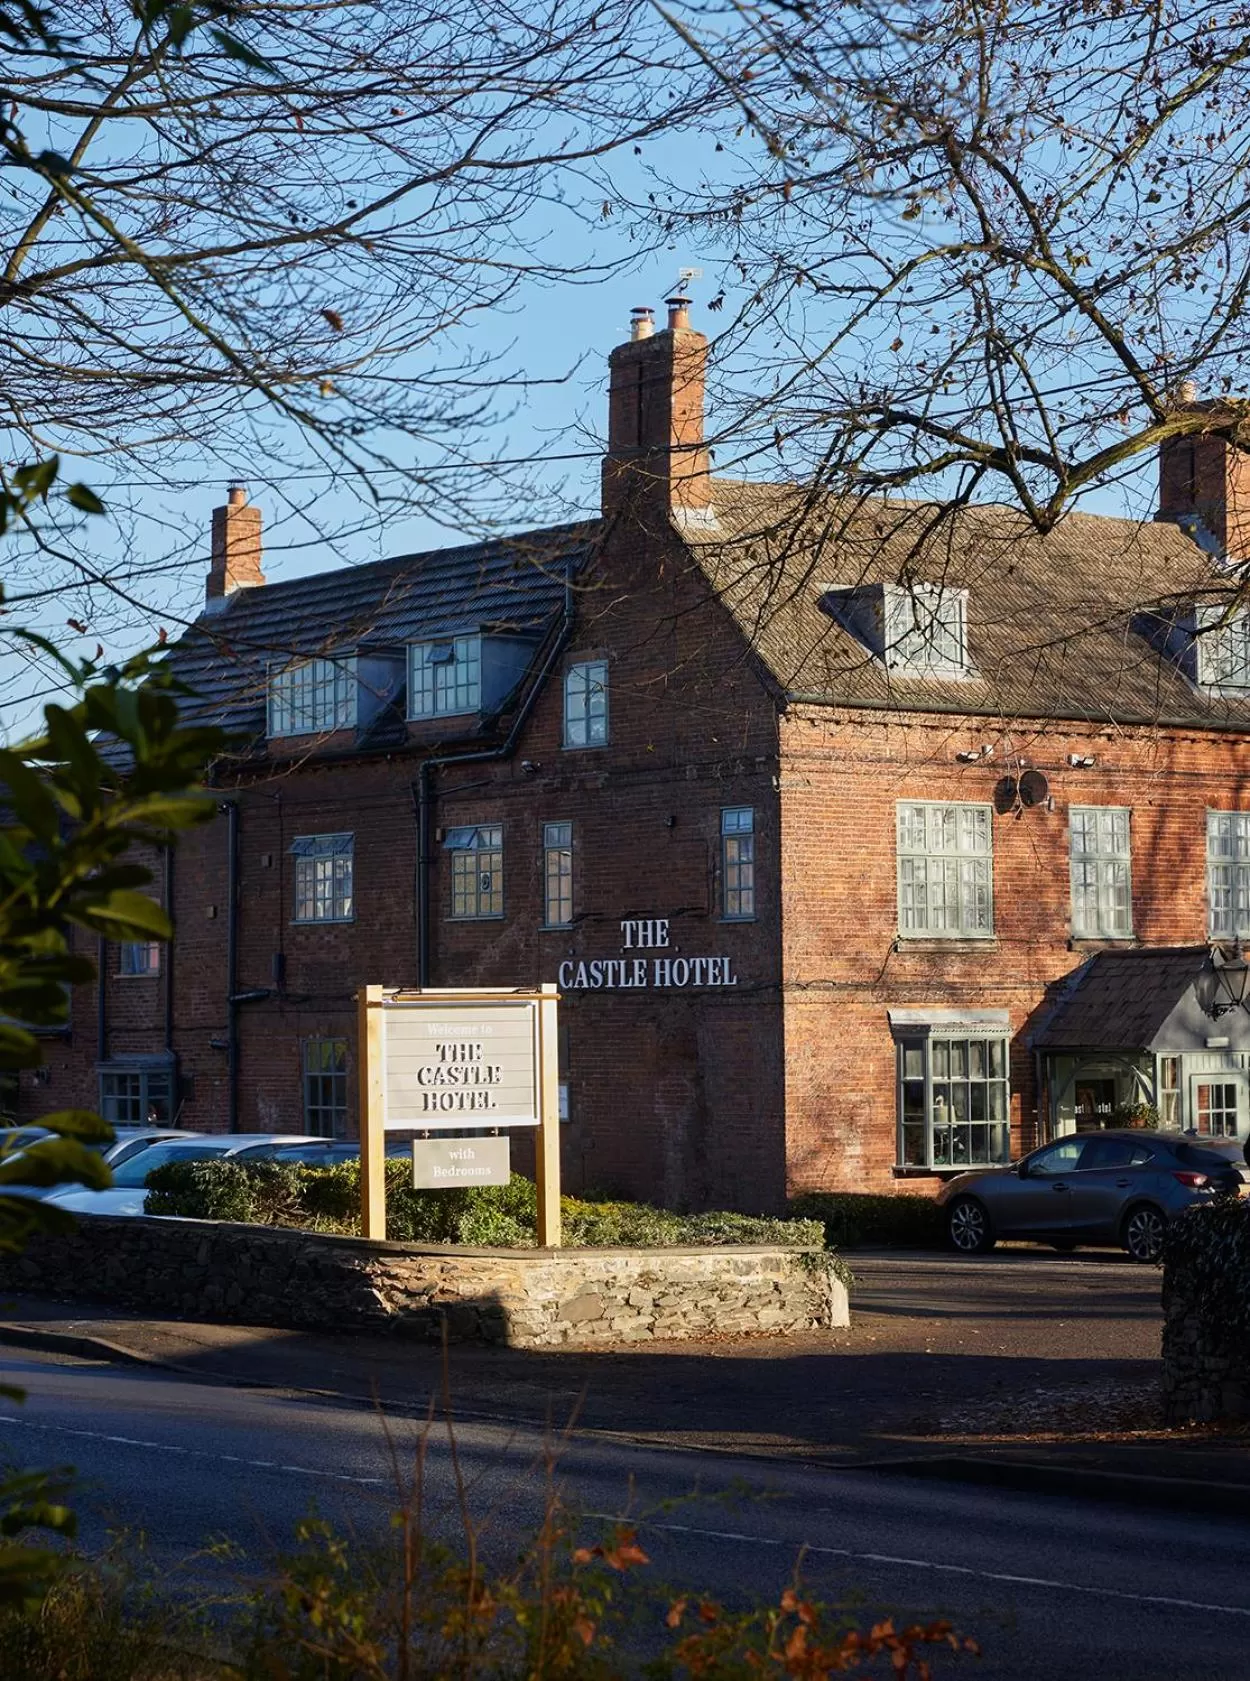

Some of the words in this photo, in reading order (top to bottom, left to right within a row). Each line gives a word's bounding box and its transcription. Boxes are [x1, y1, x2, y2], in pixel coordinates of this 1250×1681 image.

[620, 919, 669, 948] THE
[558, 959, 647, 989] CASTLE
[653, 957, 737, 987] HOTEL
[427, 1023, 479, 1036] Welcome
[480, 1023, 493, 1035] to
[435, 1044, 482, 1062] THE
[417, 1065, 502, 1086] CASTLE
[422, 1091, 497, 1111] HOTEL
[448, 1147, 476, 1160] with
[432, 1165, 493, 1178] Bedrooms
